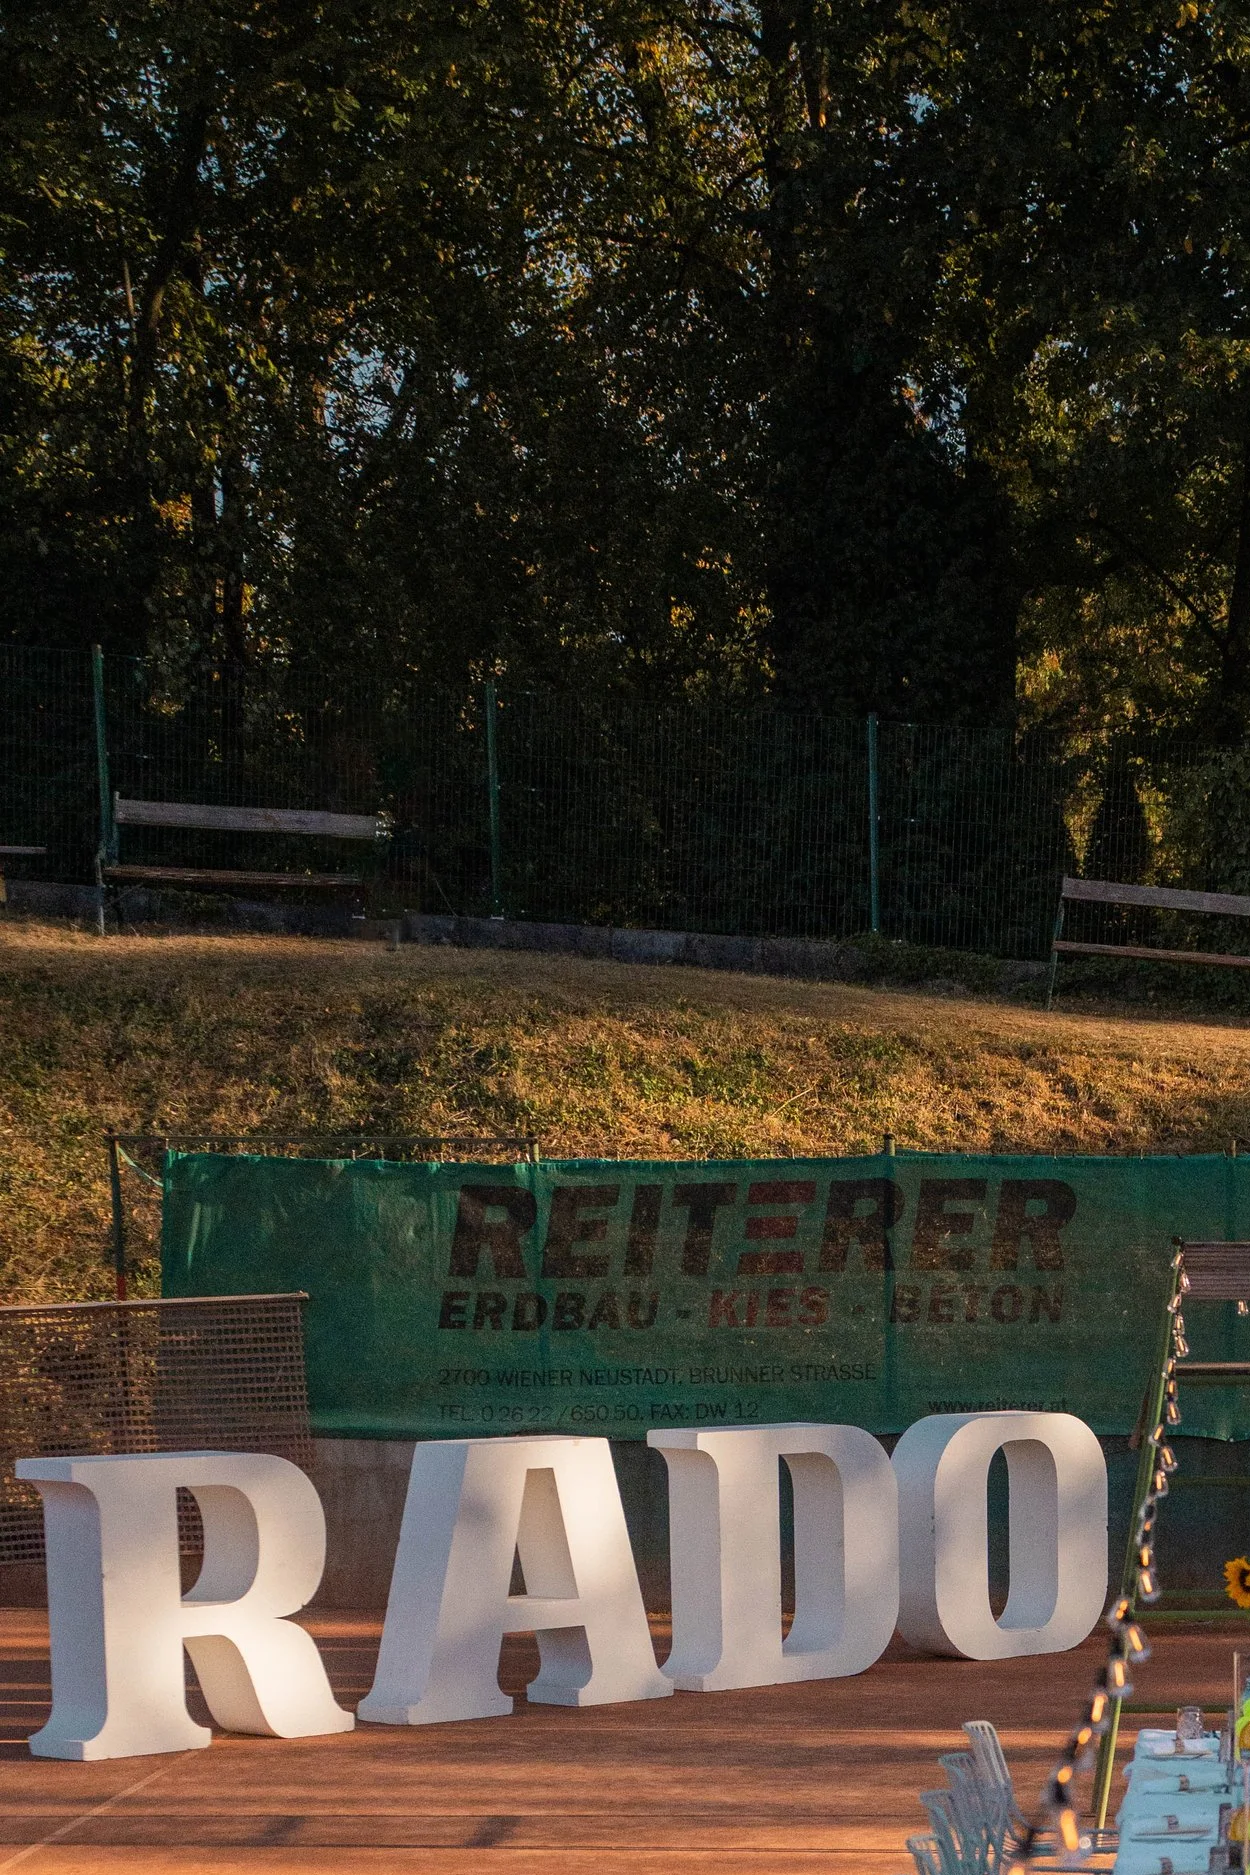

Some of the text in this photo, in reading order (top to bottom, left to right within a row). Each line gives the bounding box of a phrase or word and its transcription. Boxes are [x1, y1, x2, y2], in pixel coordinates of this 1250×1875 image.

[449, 1178, 1077, 1278] REITERER
[439, 1291, 660, 1331] ERDBAU
[708, 1285, 829, 1328] KIES
[889, 1284, 1065, 1325] BETON
[438, 1368, 491, 1386] 2700
[497, 1369, 572, 1388] WIENER
[689, 1366, 785, 1385] BRUNNER
[790, 1363, 877, 1382] STRASSE
[650, 1403, 689, 1420] FAX:
[695, 1402, 728, 1419] DW
[734, 1402, 759, 1419] 12
[14, 1410, 1108, 1762] RADO
